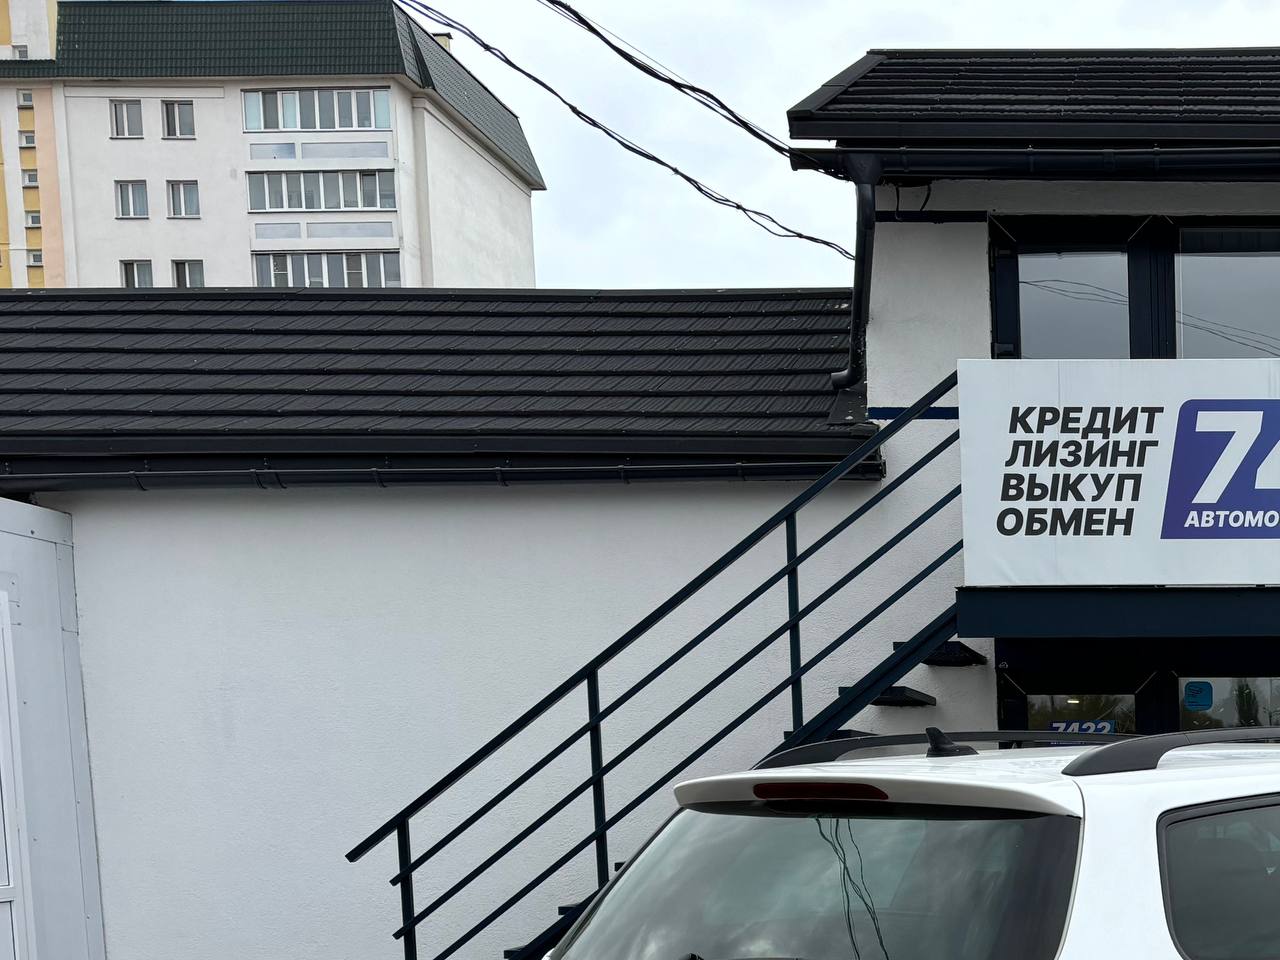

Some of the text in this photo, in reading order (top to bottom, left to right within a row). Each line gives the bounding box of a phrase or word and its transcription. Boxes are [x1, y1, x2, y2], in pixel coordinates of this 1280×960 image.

[1009, 406, 1165, 439] КРЕДИТ
[1005, 440, 1159, 468] ЛИЗИНГ
[1000, 473, 1143, 502] ВЫКУП
[996, 507, 1135, 536] ОБМЕН
